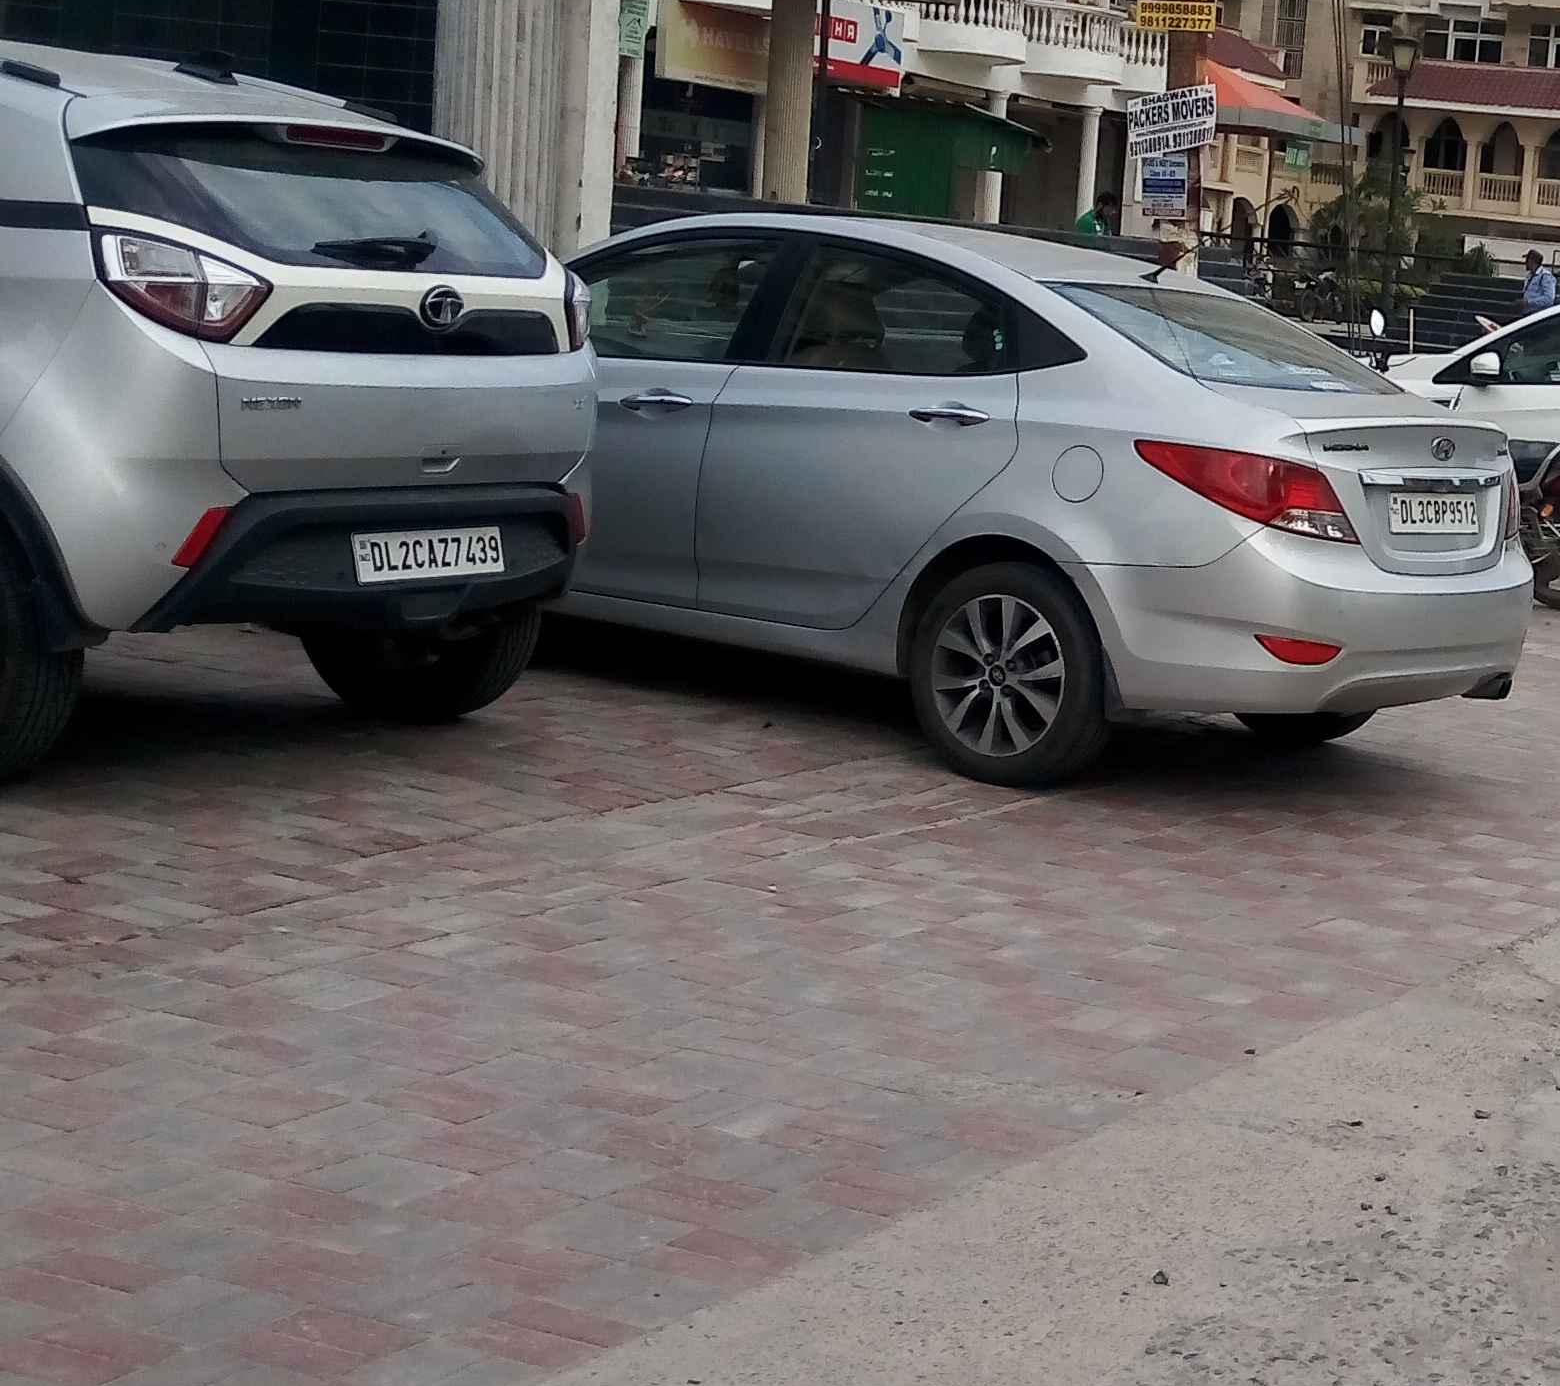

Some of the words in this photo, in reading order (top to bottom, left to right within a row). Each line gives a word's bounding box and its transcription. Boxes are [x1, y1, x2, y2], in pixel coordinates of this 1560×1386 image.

[1140, 16, 1212, 30] 9811227377
[1141, 88, 1198, 106] BHAGWATI
[1128, 103, 1170, 130] PACKERS
[1171, 95, 1215, 121] MOVERS
[1401, 500, 1476, 524] DL3CBP9512
[370, 535, 500, 572] DL2CAZ7439
